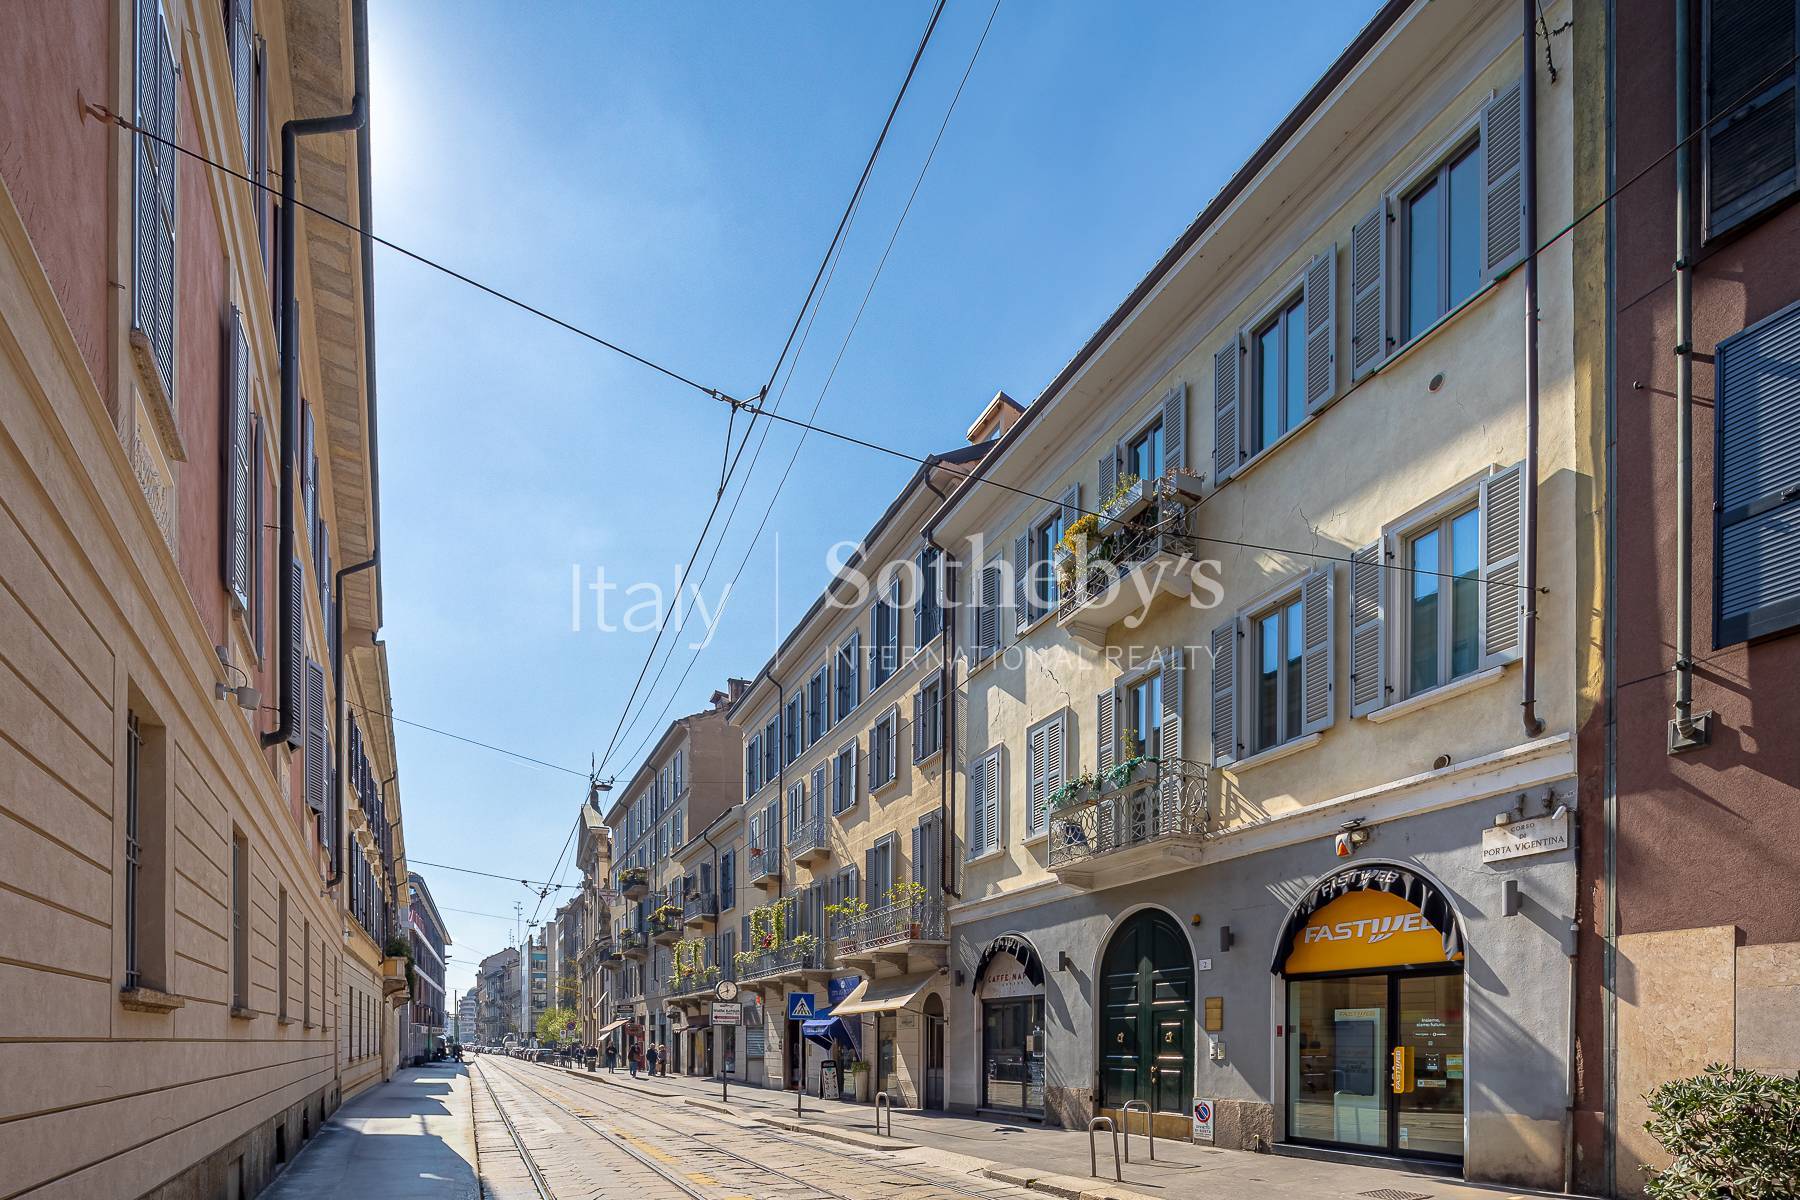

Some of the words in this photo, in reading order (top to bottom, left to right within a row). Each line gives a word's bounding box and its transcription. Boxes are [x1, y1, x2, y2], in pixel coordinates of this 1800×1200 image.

[1510, 822, 1535, 833] CORSO
[1483, 845, 1512, 857] PORTA
[1515, 835, 1565, 851] VIGENTINA
[1321, 869, 1399, 898] FASTWEB
